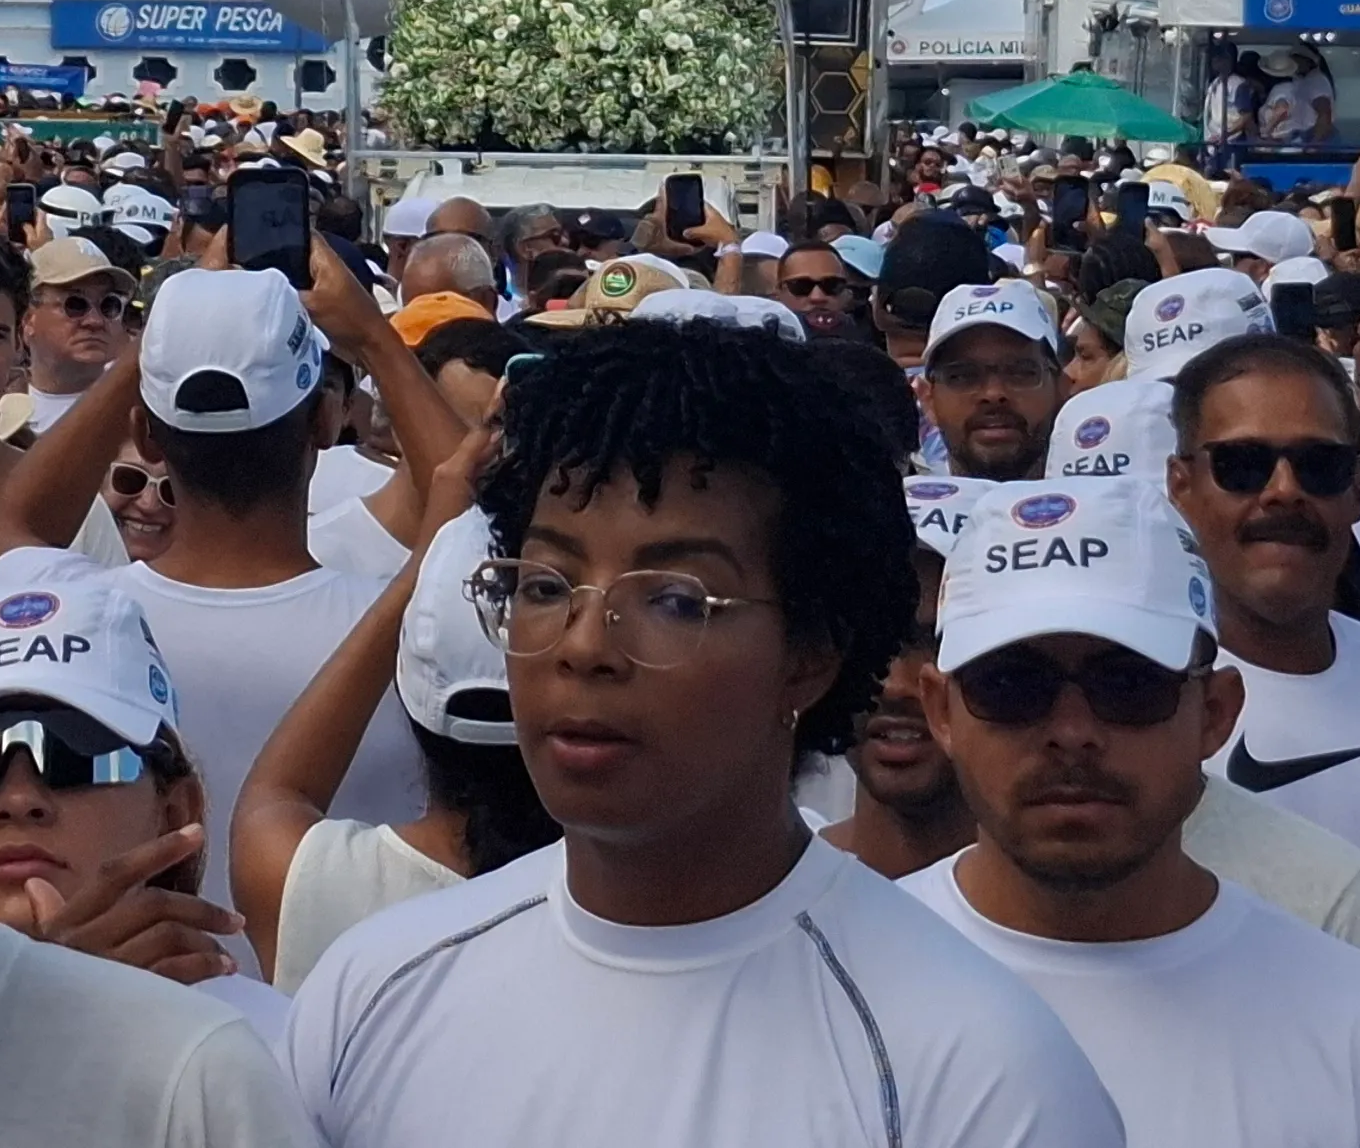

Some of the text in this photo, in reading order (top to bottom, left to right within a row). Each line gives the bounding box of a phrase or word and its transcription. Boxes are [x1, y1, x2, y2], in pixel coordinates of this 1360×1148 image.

[136, 4, 283, 34] SUPER PESCA
[919, 38, 995, 55] POLÍCIA
[954, 300, 1014, 322] SEAP
[1143, 322, 1204, 353] SEAP
[984, 536, 1109, 574] SEAP
